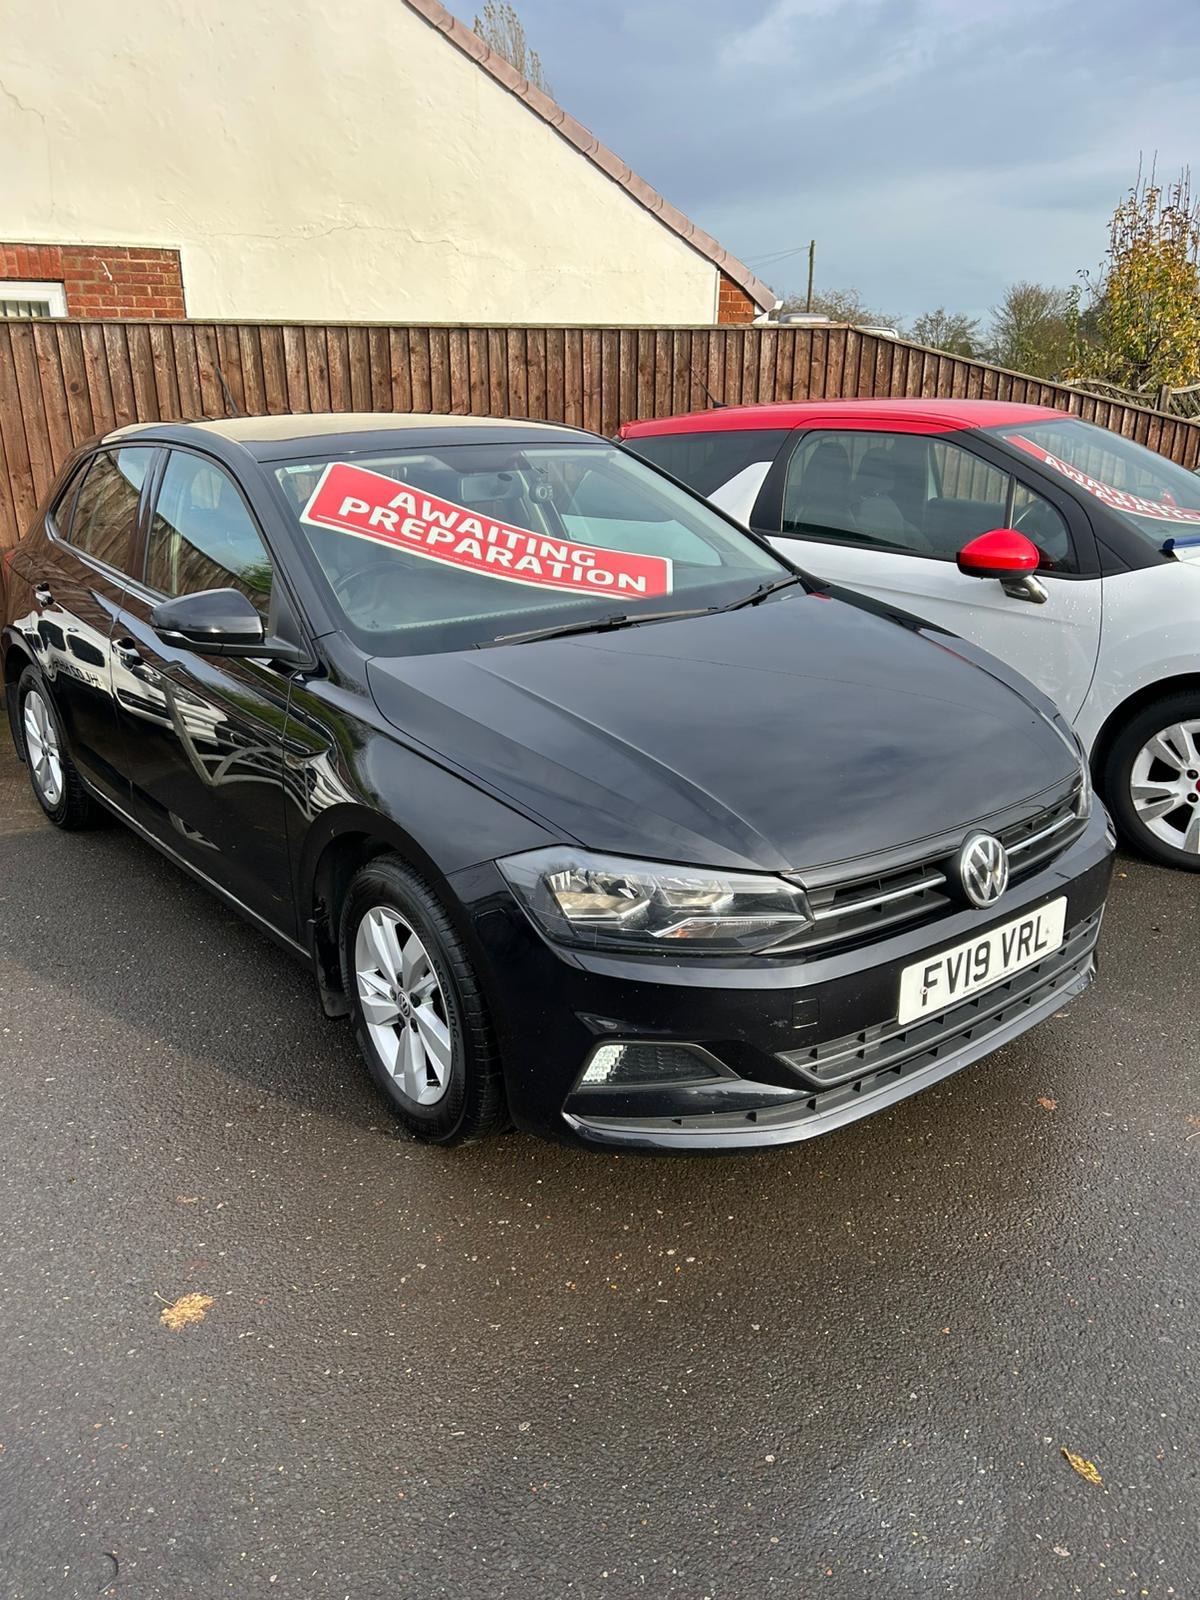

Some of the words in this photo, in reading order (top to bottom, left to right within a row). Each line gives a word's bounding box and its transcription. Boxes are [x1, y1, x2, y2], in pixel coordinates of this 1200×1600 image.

[338, 496, 646, 592] PREPARATION
[387, 491, 597, 568] AWAITING
[921, 940, 991, 1007] FV19
[1002, 915, 1048, 969] VRL
